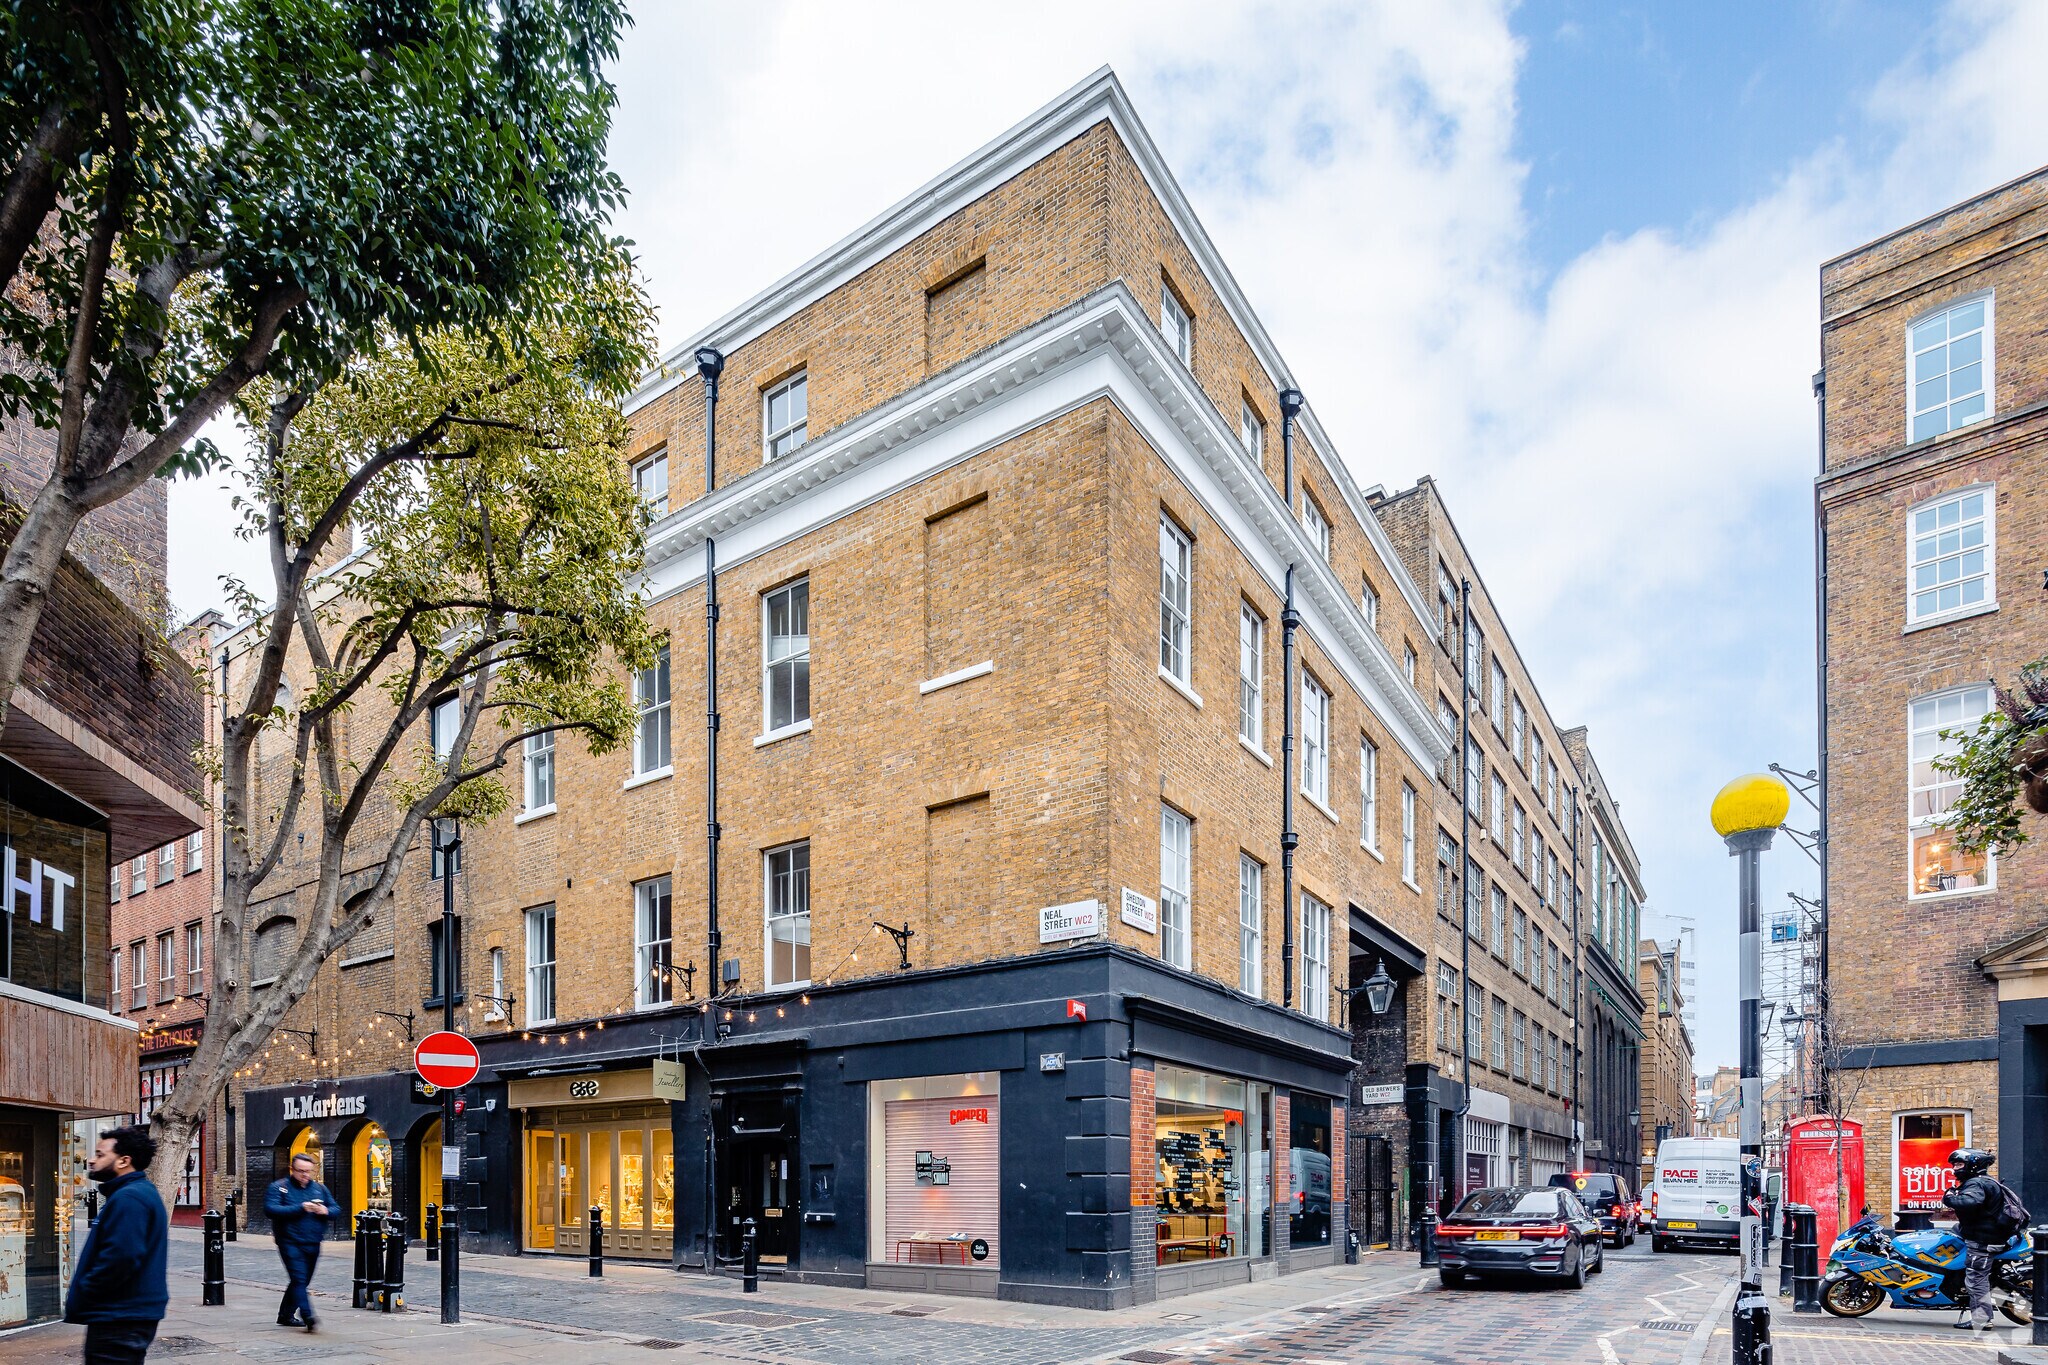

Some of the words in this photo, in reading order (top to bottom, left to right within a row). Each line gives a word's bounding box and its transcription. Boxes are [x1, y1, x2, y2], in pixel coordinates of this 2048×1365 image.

[1126, 892, 1146, 908] SHELTON
[1044, 909, 1062, 920] NEAL
[1126, 904, 1143, 917] STREET
[1144, 910, 1154, 921] WC2
[1044, 918, 1072, 931] STREET
[1075, 914, 1093, 926] WC2
[141, 1037, 154, 1051] THE
[655, 1076, 684, 1094] Jewellery
[950, 1108, 988, 1125] CAMPER
[1662, 1169, 1698, 1178] PACE
[1902, 1164, 1941, 1176] sale
[1908, 1201, 1919, 1209] ON
